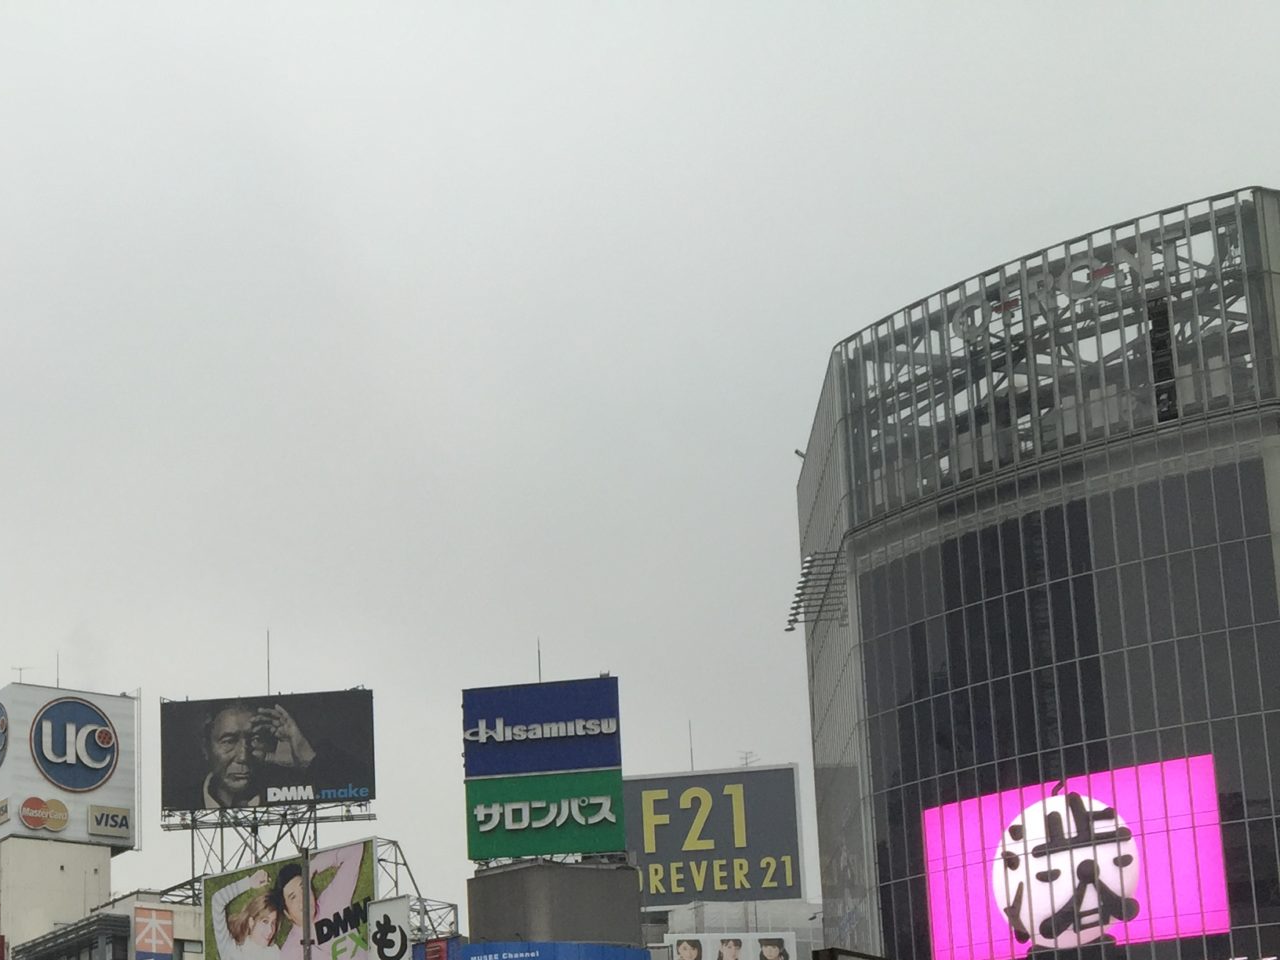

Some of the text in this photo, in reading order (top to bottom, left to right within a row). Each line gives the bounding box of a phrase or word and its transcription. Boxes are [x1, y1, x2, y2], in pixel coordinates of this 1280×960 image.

[41, 719, 114, 769] UC
[463, 717, 617, 744] Hisamitsu
[267, 783, 370, 802] DMM.make
[22, 807, 69, 821] MasterCard
[94, 812, 130, 830] VISA
[473, 794, 617, 833] サロンパス
[640, 783, 749, 855] F21
[760, 856, 794, 888] 21
[315, 896, 371, 945] DMM
[502, 950, 540, 960] Channel
